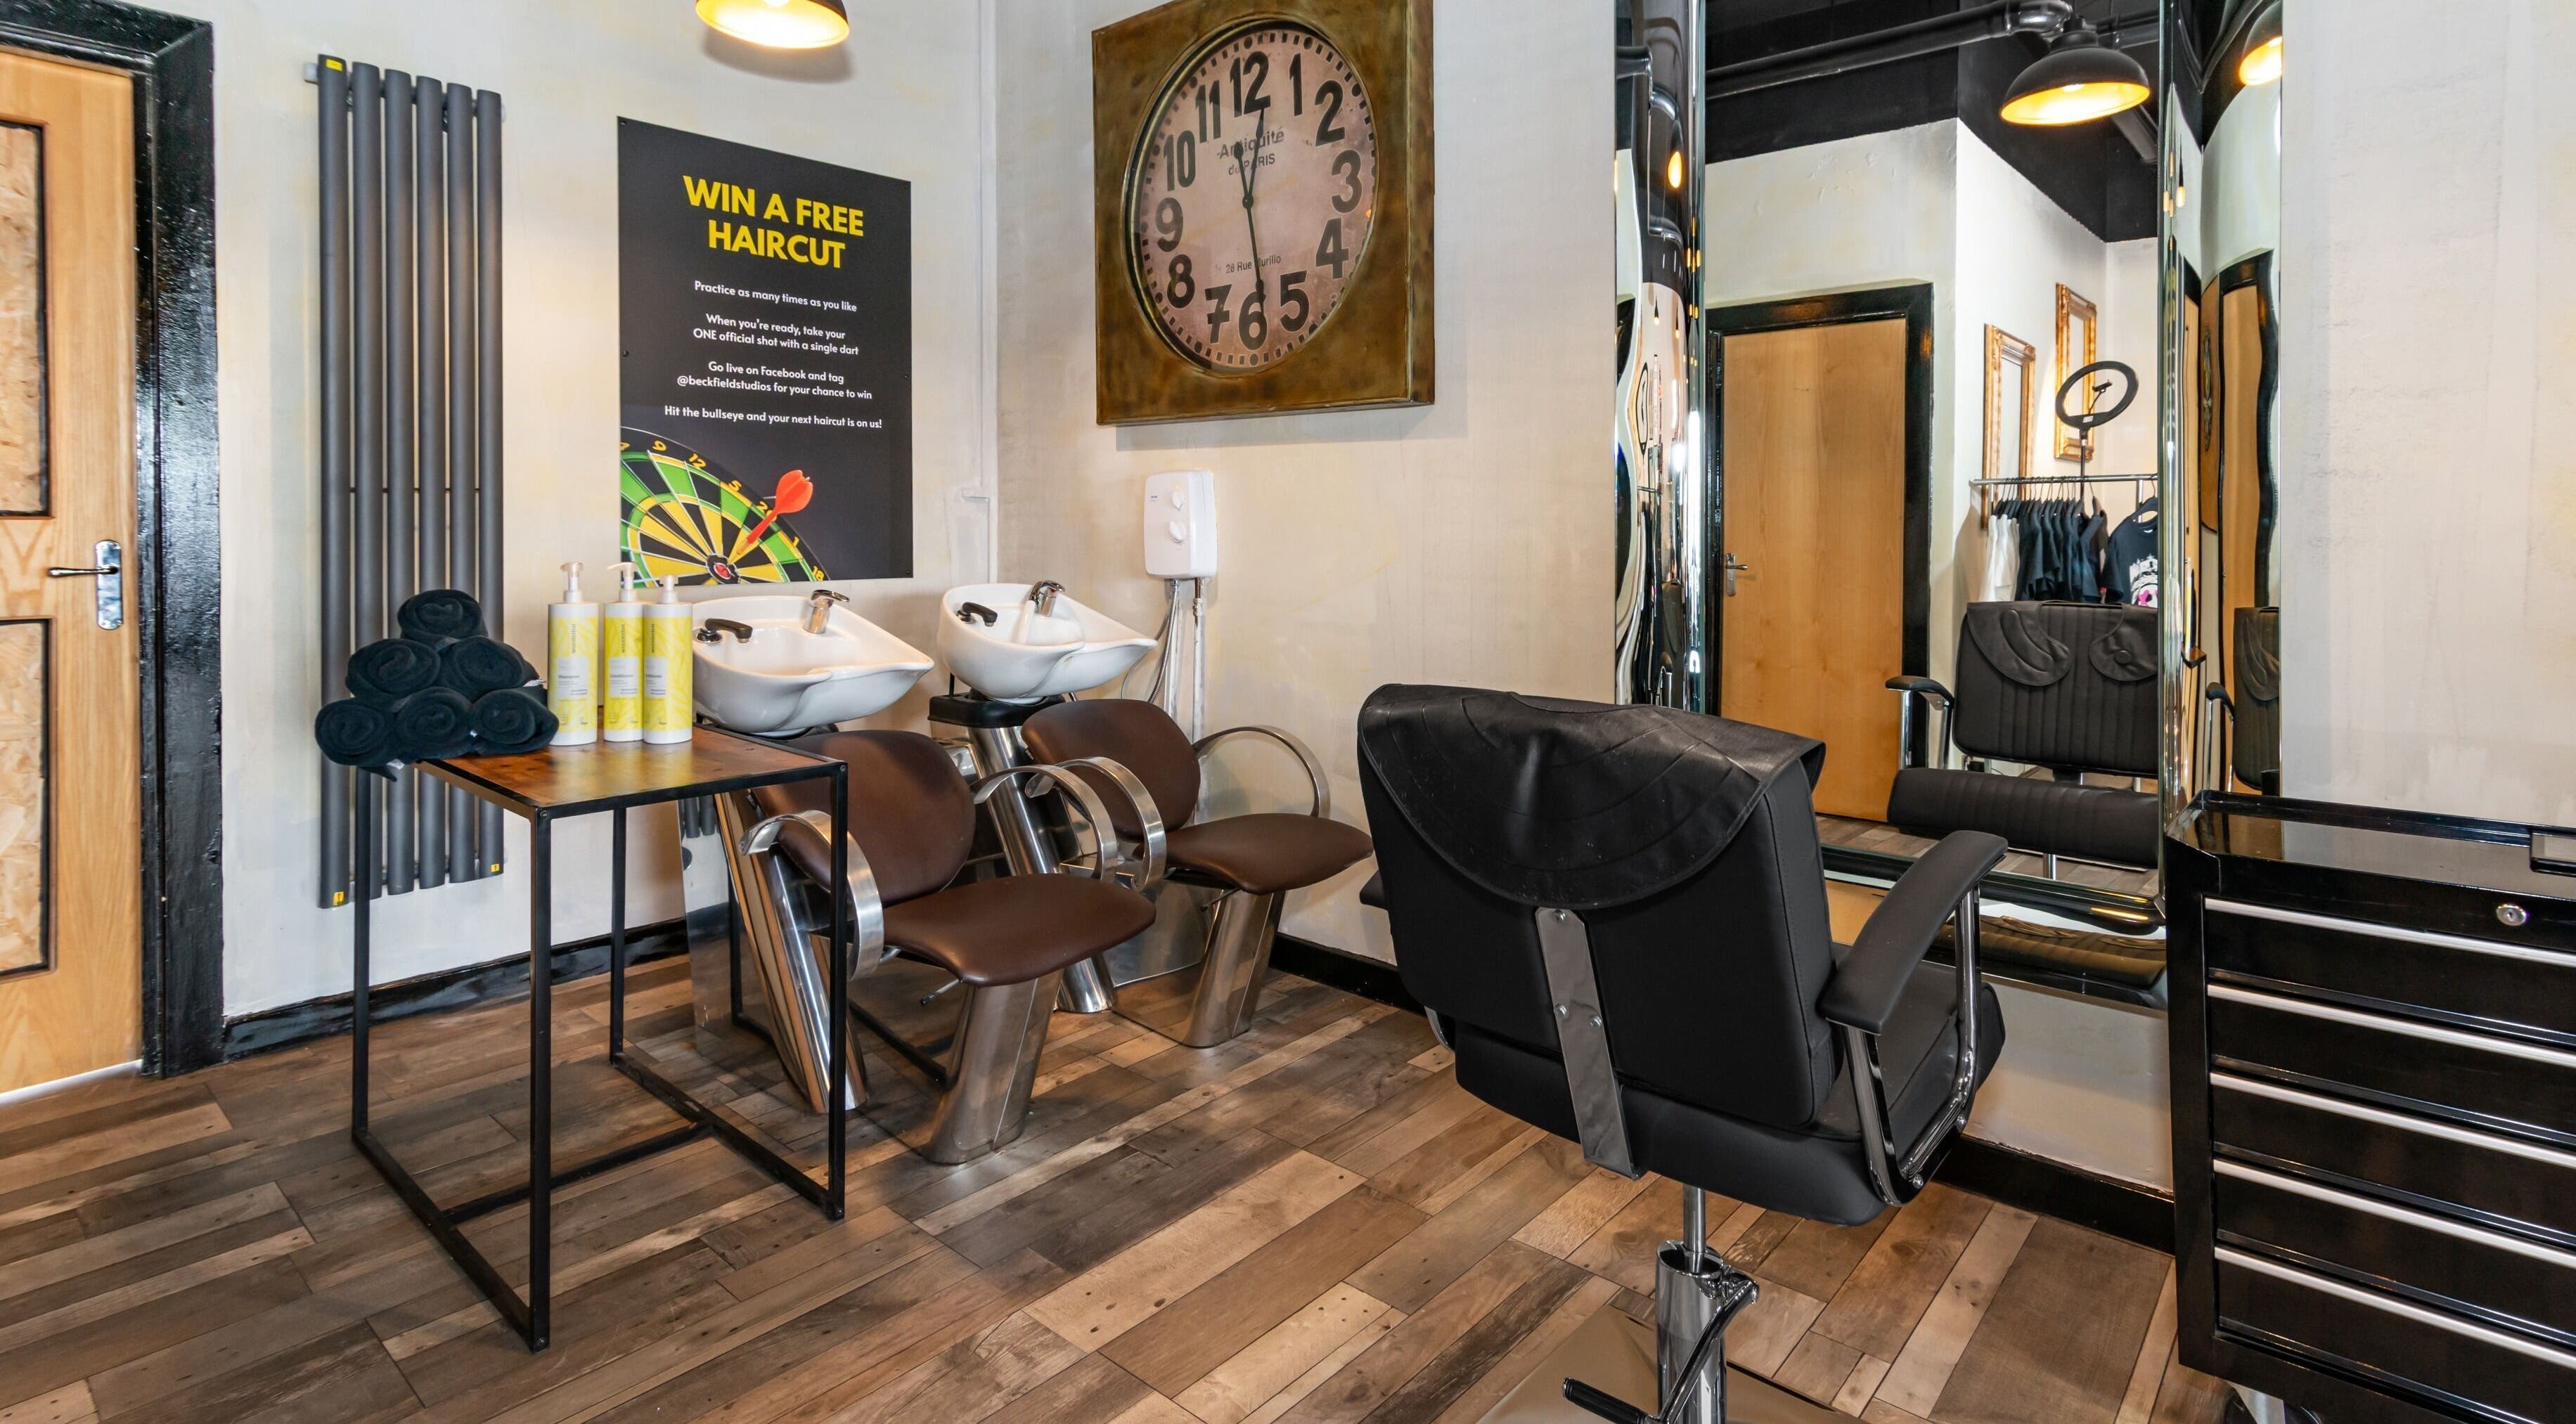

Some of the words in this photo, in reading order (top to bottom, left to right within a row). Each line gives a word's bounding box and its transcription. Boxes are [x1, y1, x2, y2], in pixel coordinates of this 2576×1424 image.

[1230, 51, 1271, 117] 12
[1289, 53, 1303, 117] 1
[1195, 79, 1222, 143] 11
[1315, 80, 1346, 147] 2
[1164, 130, 1196, 192] 10
[1332, 150, 1363, 214] 3
[683, 175, 755, 216] WIN
[764, 193, 789, 223] A
[797, 198, 863, 236] FREE
[1155, 198, 1183, 253] 9
[709, 219, 846, 268] HAIRCUT
[1225, 263, 1235, 273] 28
[1237, 261, 1252, 272] Rue
[1255, 254, 1281, 267] urillo
[1316, 219, 1349, 280] 4
[695, 280, 735, 295] Practice
[752, 292, 780, 304] many
[782, 294, 808, 305] times
[823, 301, 839, 310] you
[842, 301, 857, 311] like
[1167, 254, 1195, 309] 8
[1280, 271, 1310, 332] 5
[706, 313, 736, 326] When
[738, 318, 769, 330] you're
[771, 324, 801, 336] ready,
[803, 326, 823, 337] take
[825, 331, 846, 339] your
[1204, 283, 1232, 344] 7
[1239, 287, 1268, 350] 6
[693, 328, 717, 340] ONE
[719, 332, 754, 344] official
[756, 335, 778, 347] shot
[780, 339, 799, 349] with
[811, 342, 837, 354] single
[839, 344, 858, 355] dart
[677, 375, 771, 391] @beckfieldstudios
[773, 382, 787, 392] for
[789, 387, 810, 396] your
[812, 386, 844, 397] chance
[846, 389, 855, 398] to
[857, 390, 872, 399] win
[708, 361, 724, 372] Go
[726, 363, 744, 374] live
[761, 366, 806, 379] Facebook
[808, 372, 826, 381] and
[828, 373, 844, 384] tag
[664, 406, 681, 416] Hit
[682, 407, 700, 418] the
[702, 408, 745, 422] bullseye
[746, 412, 766, 421] and
[768, 415, 790, 425] your
[792, 415, 812, 424] next
[814, 415, 846, 426] haircut
[847, 418, 855, 427] is
[870, 419, 882, 428] us!
[652, 440, 666, 451] 9
[688, 453, 707, 469] 12
[728, 480, 742, 492] 5
[793, 536, 799, 548] 1
[812, 566, 825, 581] 18
